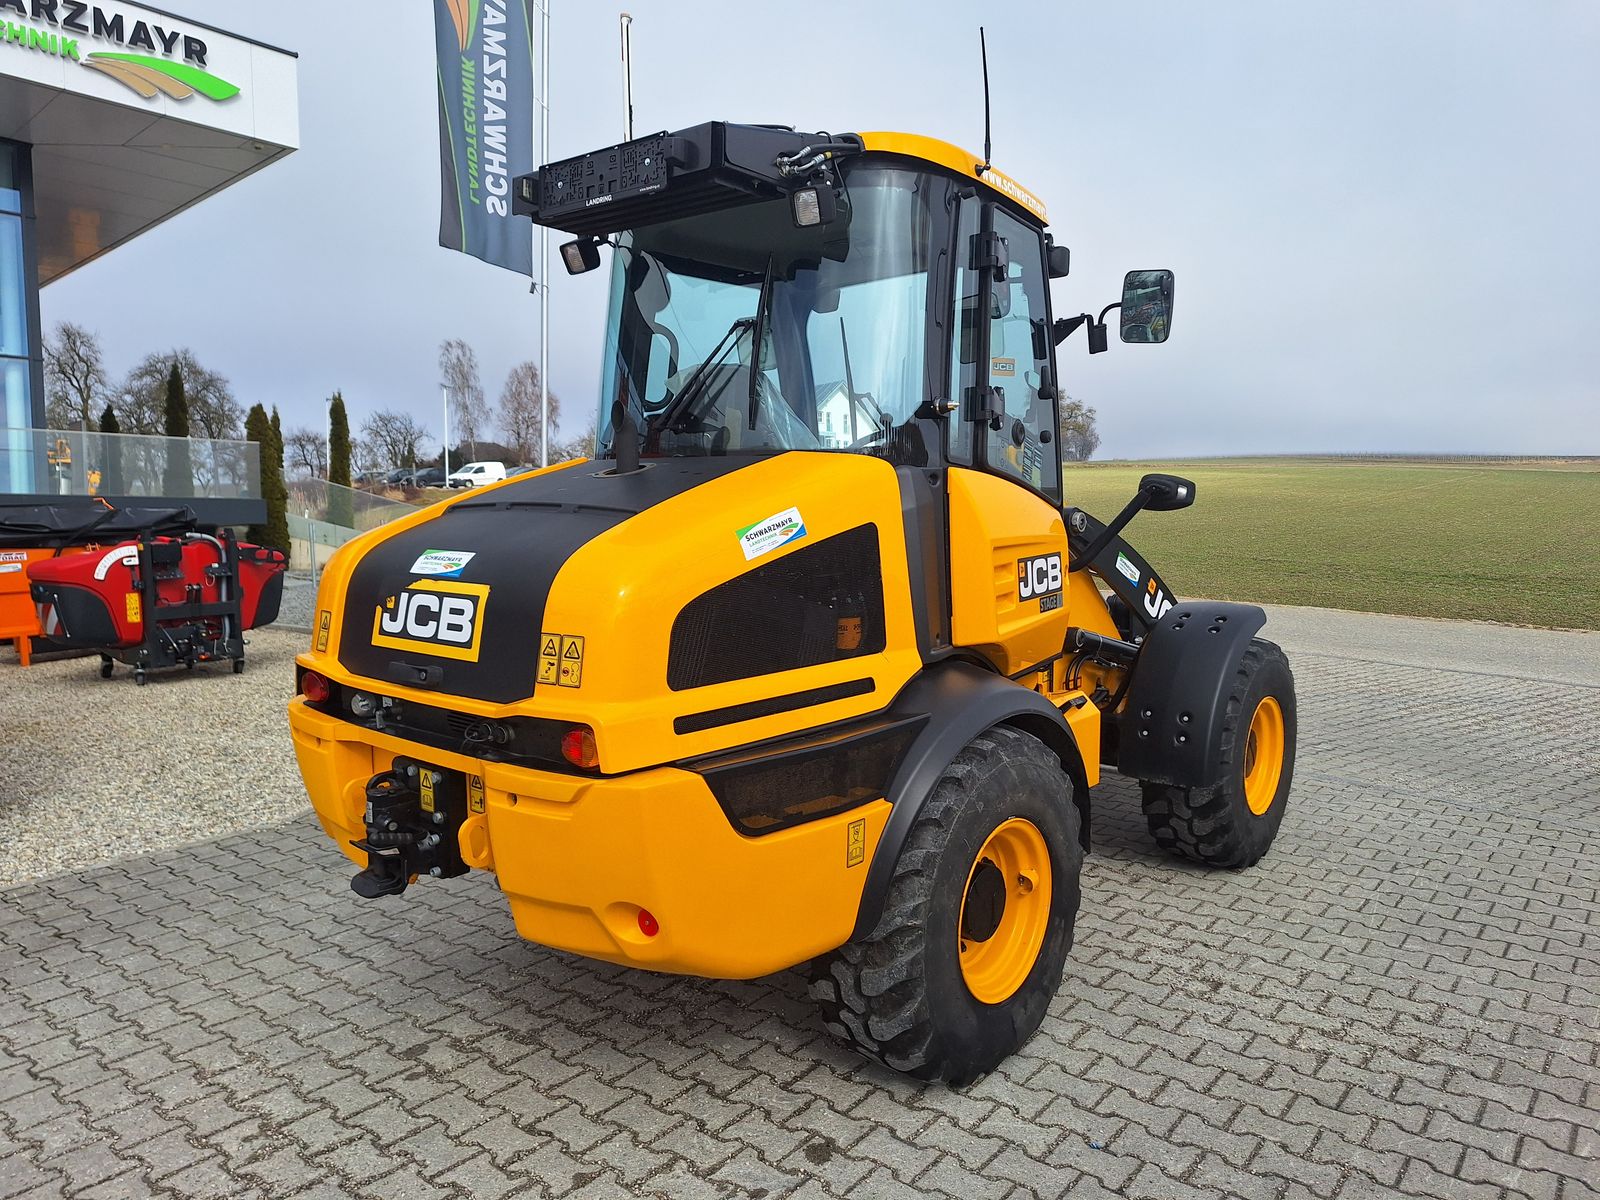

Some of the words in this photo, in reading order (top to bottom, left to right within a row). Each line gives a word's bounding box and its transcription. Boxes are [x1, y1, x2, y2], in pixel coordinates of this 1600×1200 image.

[585, 194, 612, 206] LANDRING
[993, 363, 1015, 371] JCB
[745, 516, 793, 542] SCHWARZMAYR
[1020, 555, 1062, 598] JCB
[1040, 595, 1057, 611] STAGE
[381, 592, 474, 643] JCB
